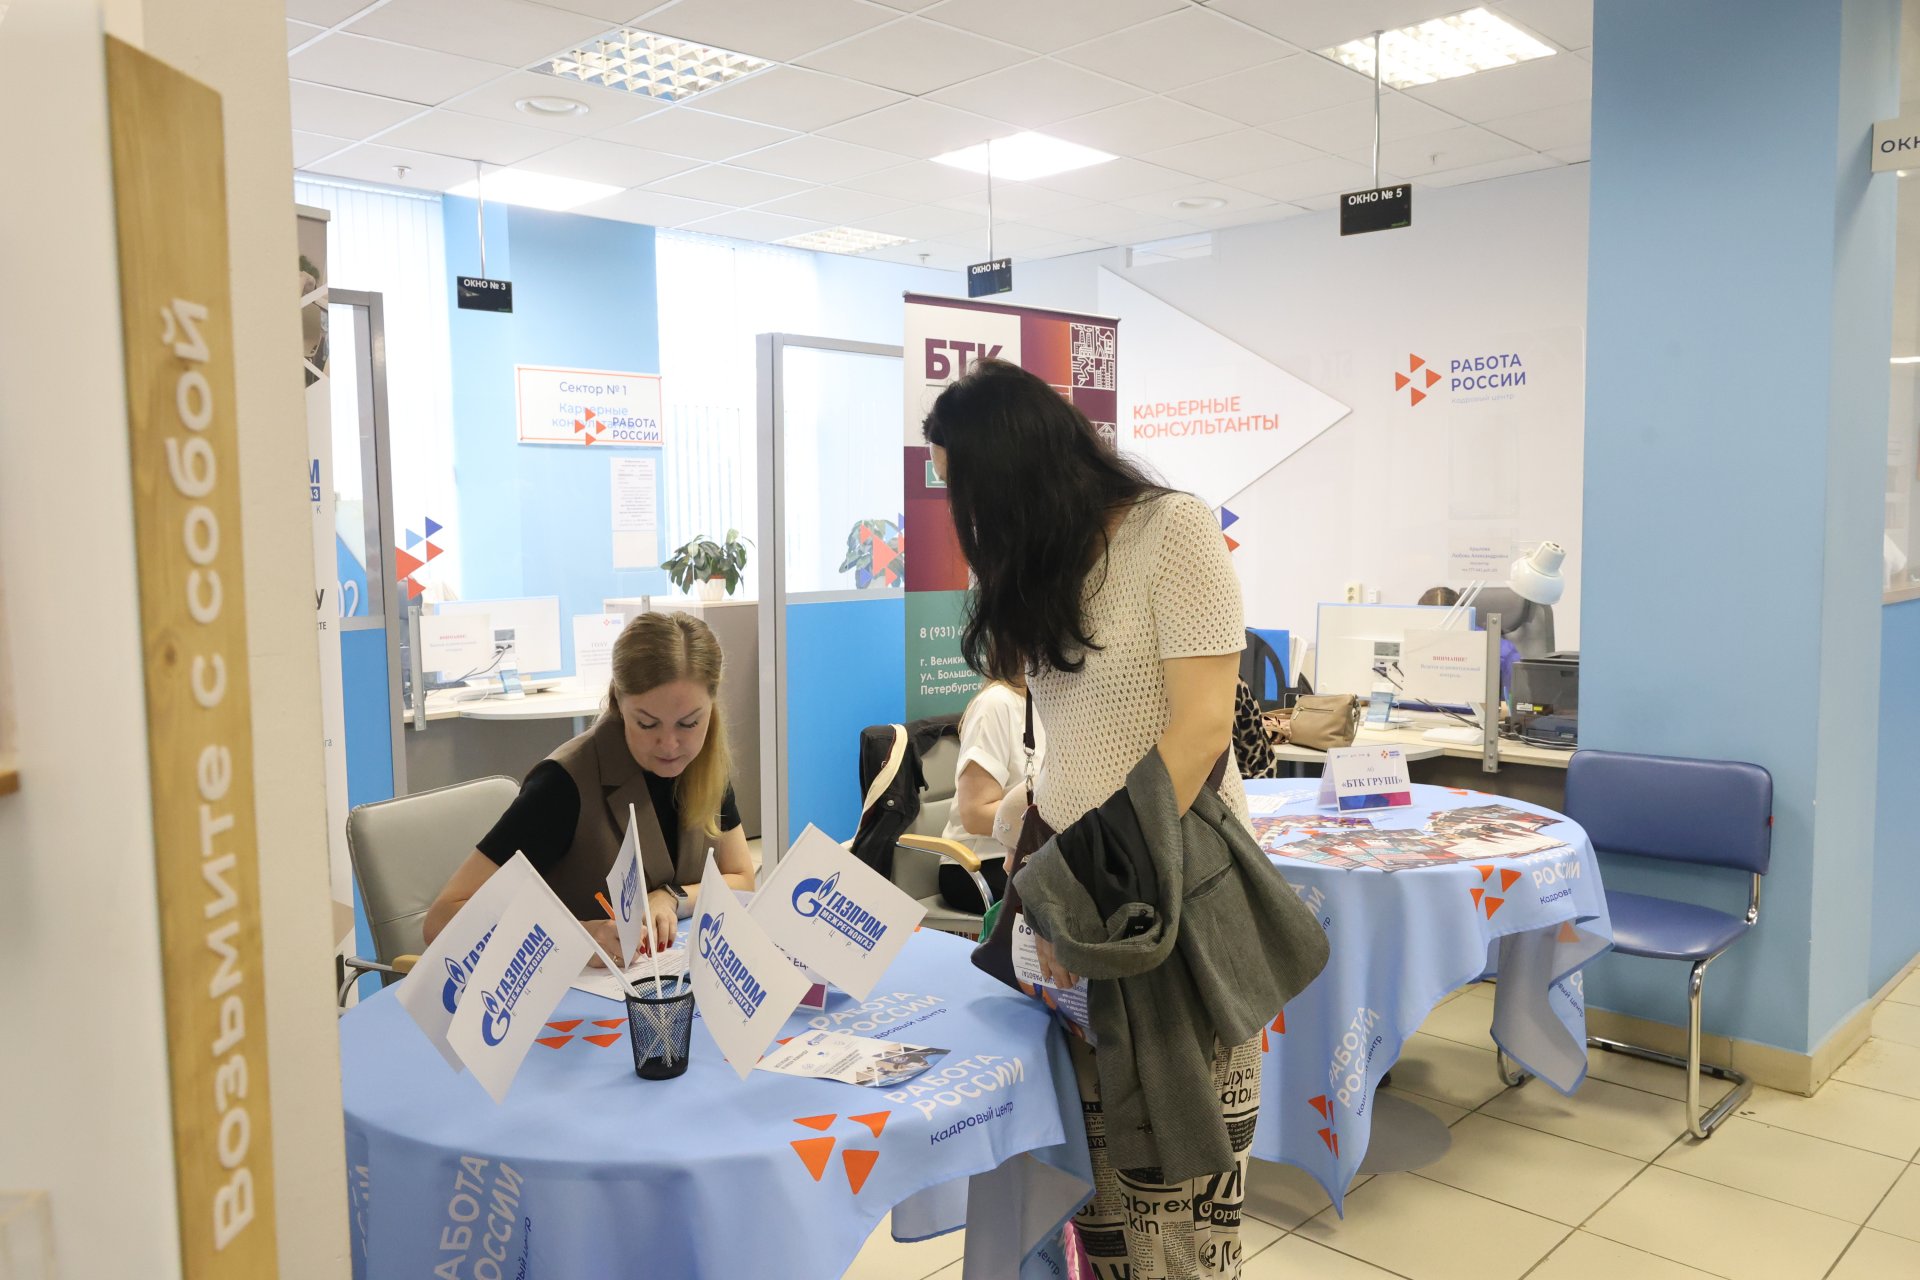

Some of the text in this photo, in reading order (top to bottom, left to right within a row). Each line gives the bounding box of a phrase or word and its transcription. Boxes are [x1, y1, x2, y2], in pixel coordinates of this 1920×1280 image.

[1348, 188, 1403, 206] ОКНО № 5
[971, 261, 1006, 275] ОКНО № 4
[463, 279, 506, 290] ОКНО № 3
[1451, 353, 1522, 373] РАБОТА
[559, 381, 627, 396] Сектор № 1
[1451, 371, 1526, 391] РОССИИ
[1133, 396, 1241, 420] КАРЬЕРНЫЕ
[612, 417, 657, 429] РАБОТА
[612, 429, 659, 441] РОССИИ
[1133, 414, 1279, 439] КОНСУЛЬТАНТЫ
[919, 627, 927, 639] 8
[929, 626, 955, 640] (931)
[920, 658, 928, 667] г.
[920, 673, 935, 684] ул.
[920, 682, 984, 695] Петербургск
[161, 297, 256, 1251] Возьмите с собой
[1539, 888, 1572, 905] Кадров
[826, 891, 888, 942] ГАЗПРОМ
[819, 908, 875, 951] МЕЖРЕГИОНГАЗ
[494, 922, 547, 1004] ГАЗПРОМ
[506, 938, 554, 1011] МЕЖРЕГИОНГАЗ
[714, 934, 767, 1008] ГАЗПРОМ
[709, 952, 755, 1018] МЕЖРЕГИОНГАЗ
[1328, 1007, 1366, 1089] РАБОТА
[883, 1054, 1004, 1104] РАБОТА
[911, 1056, 1025, 1121] РОССИИ
[930, 1101, 1014, 1146] Кадровый центр
[1119, 1191, 1193, 1216] abrex
[434, 1156, 489, 1280] АБОТА
[473, 1162, 525, 1280] ОССИИ
